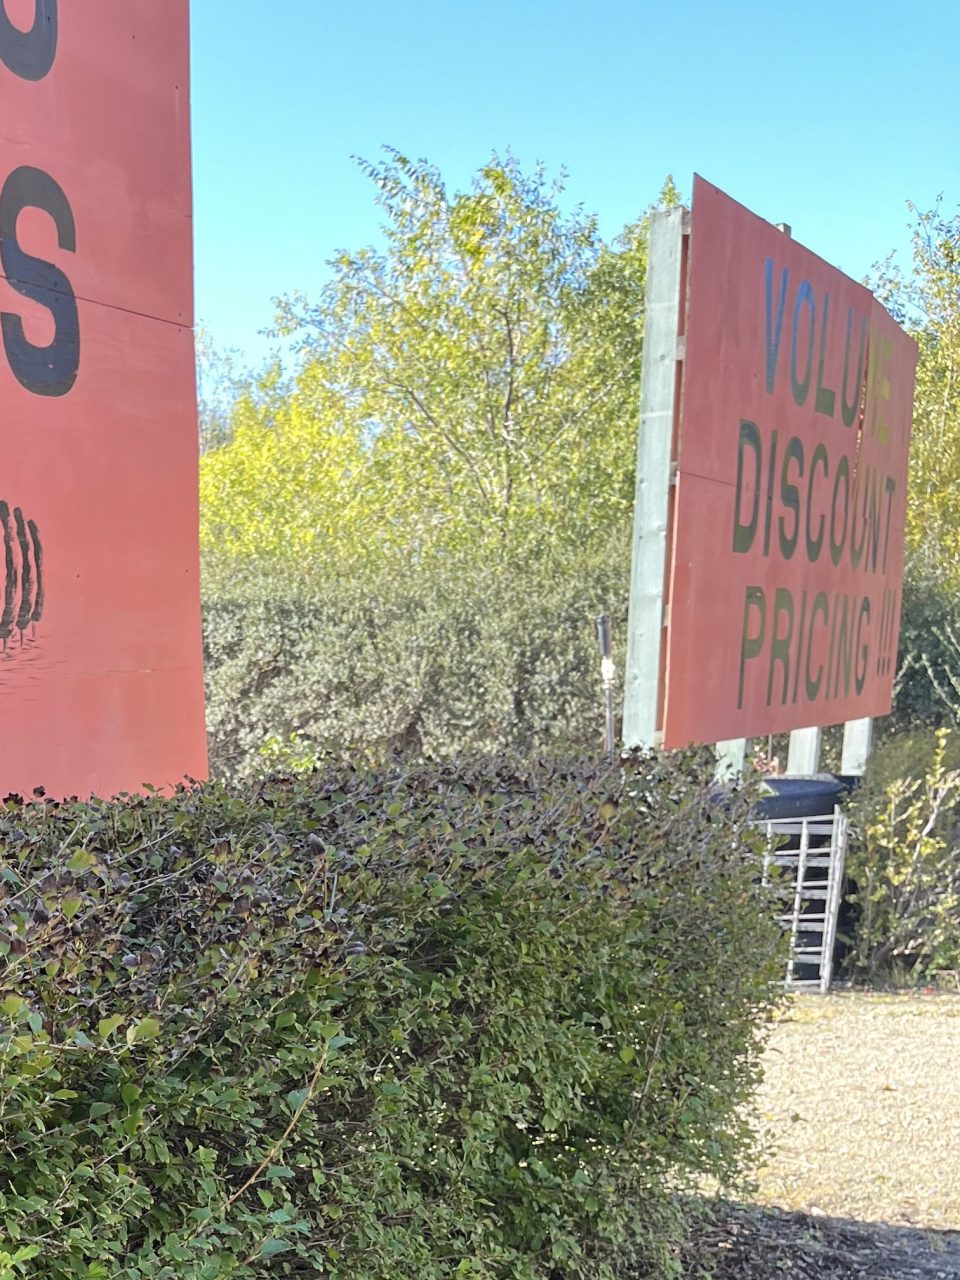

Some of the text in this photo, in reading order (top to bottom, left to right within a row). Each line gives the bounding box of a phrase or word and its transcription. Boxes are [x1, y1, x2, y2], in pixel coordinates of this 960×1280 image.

[763, 256, 892, 449] VOLUE
[732, 417, 896, 577] DISCOUNT
[736, 585, 871, 710] PRICING
